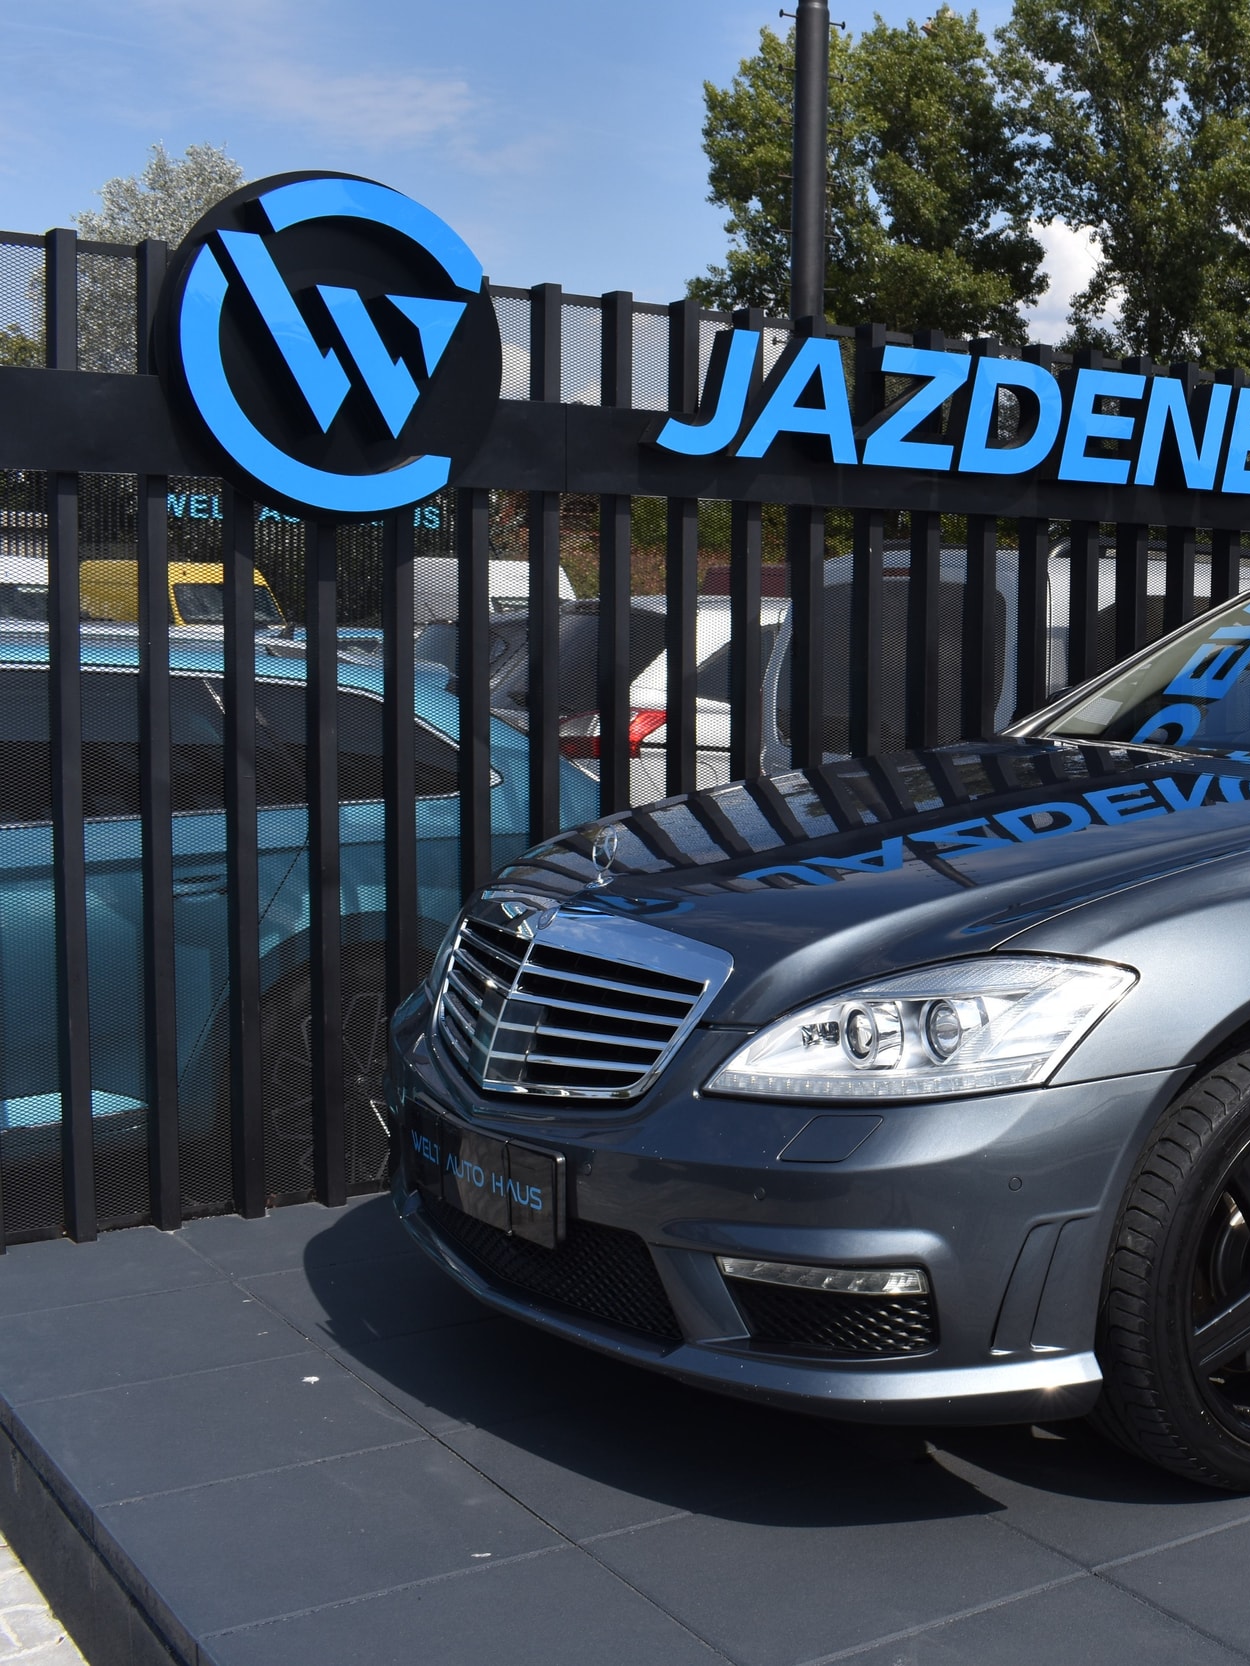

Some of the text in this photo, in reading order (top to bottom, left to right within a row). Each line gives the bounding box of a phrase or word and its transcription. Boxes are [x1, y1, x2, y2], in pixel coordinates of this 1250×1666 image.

[411, 1129, 543, 1211] WELT AUTO HAUS
